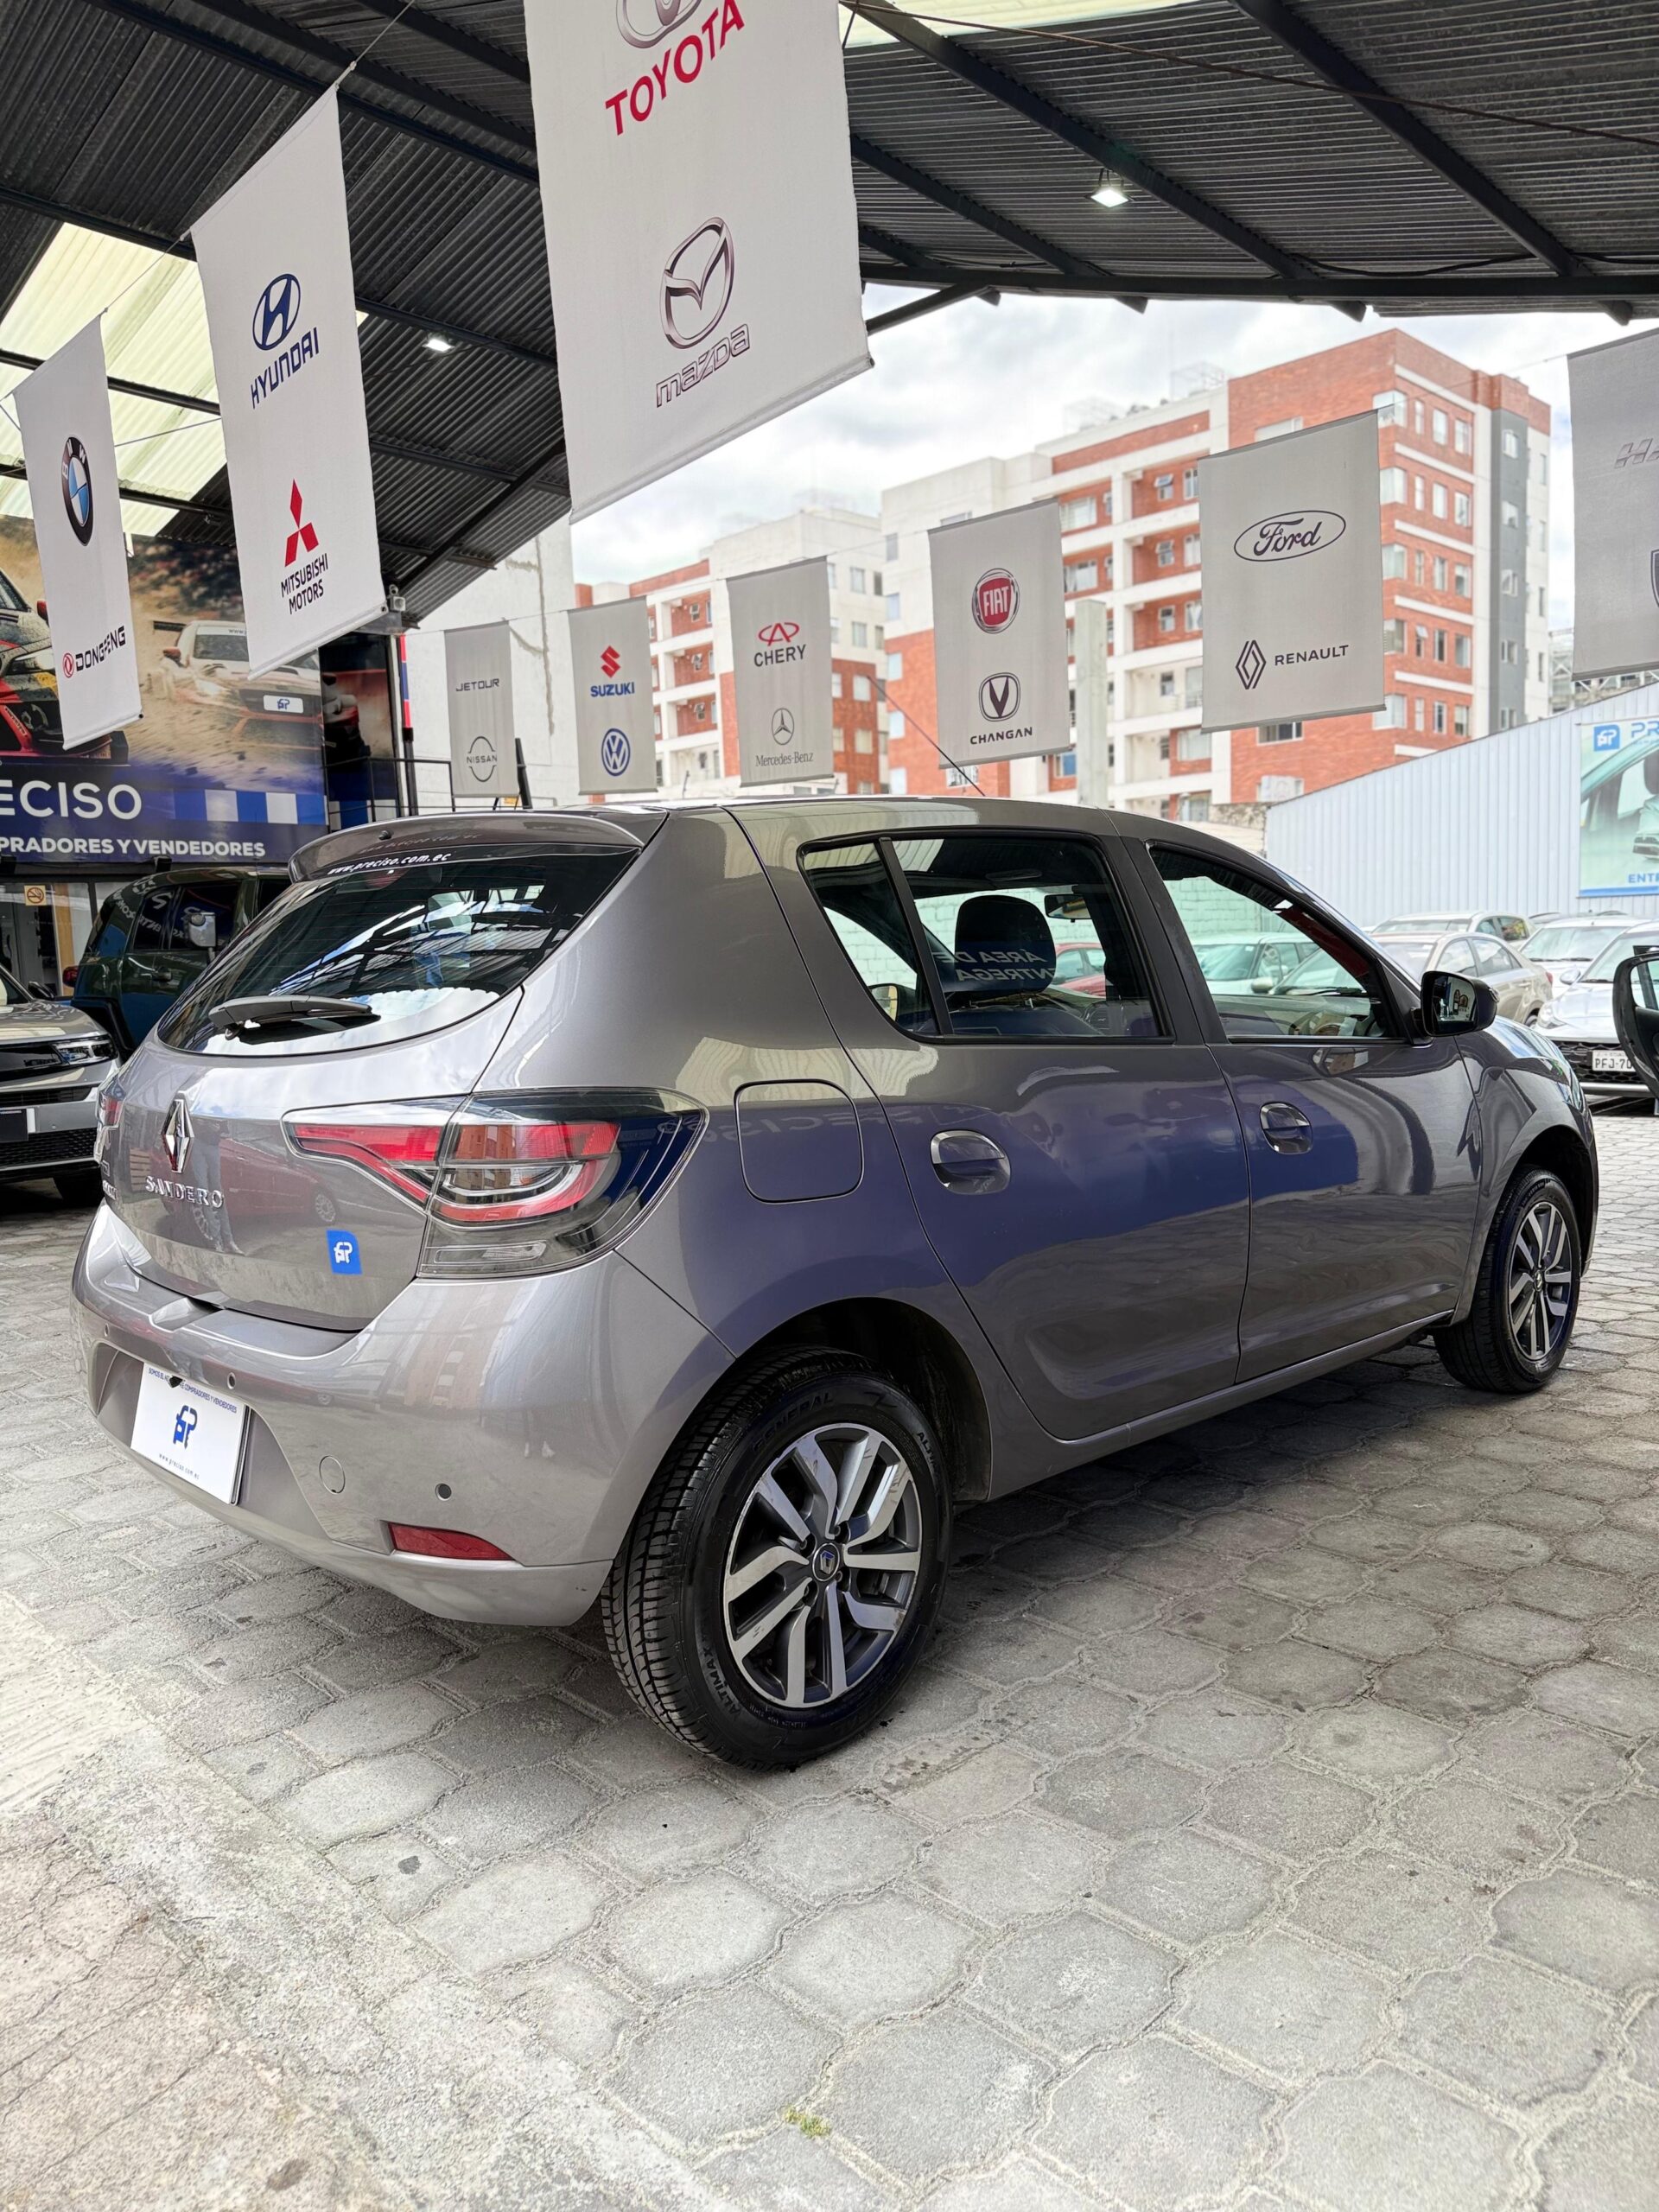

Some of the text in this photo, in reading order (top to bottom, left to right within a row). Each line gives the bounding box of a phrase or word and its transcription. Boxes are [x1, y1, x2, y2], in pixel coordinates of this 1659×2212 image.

[605, 0, 745, 136] TOYOTA
[251, 327, 320, 410] HYUNDAI
[1254, 518, 1323, 556] Ford
[281, 553, 328, 598] MITSUBISHI
[289, 578, 324, 614] MOTORS
[982, 586, 1009, 617] FIAT
[753, 644, 807, 667] CHERY
[1274, 645, 1349, 666] RENAULT
[455, 677, 499, 692] JETOUR
[590, 681, 636, 698] SUZUKI
[970, 727, 1033, 745] CHANGAN
[467, 753, 498, 764] NISSAN
[755, 751, 814, 767] Mercedes-Benz
[117, 839, 131, 854] Y
[132, 839, 266, 857] VENDEDORES
[145, 1175, 225, 1208] SANDERO
